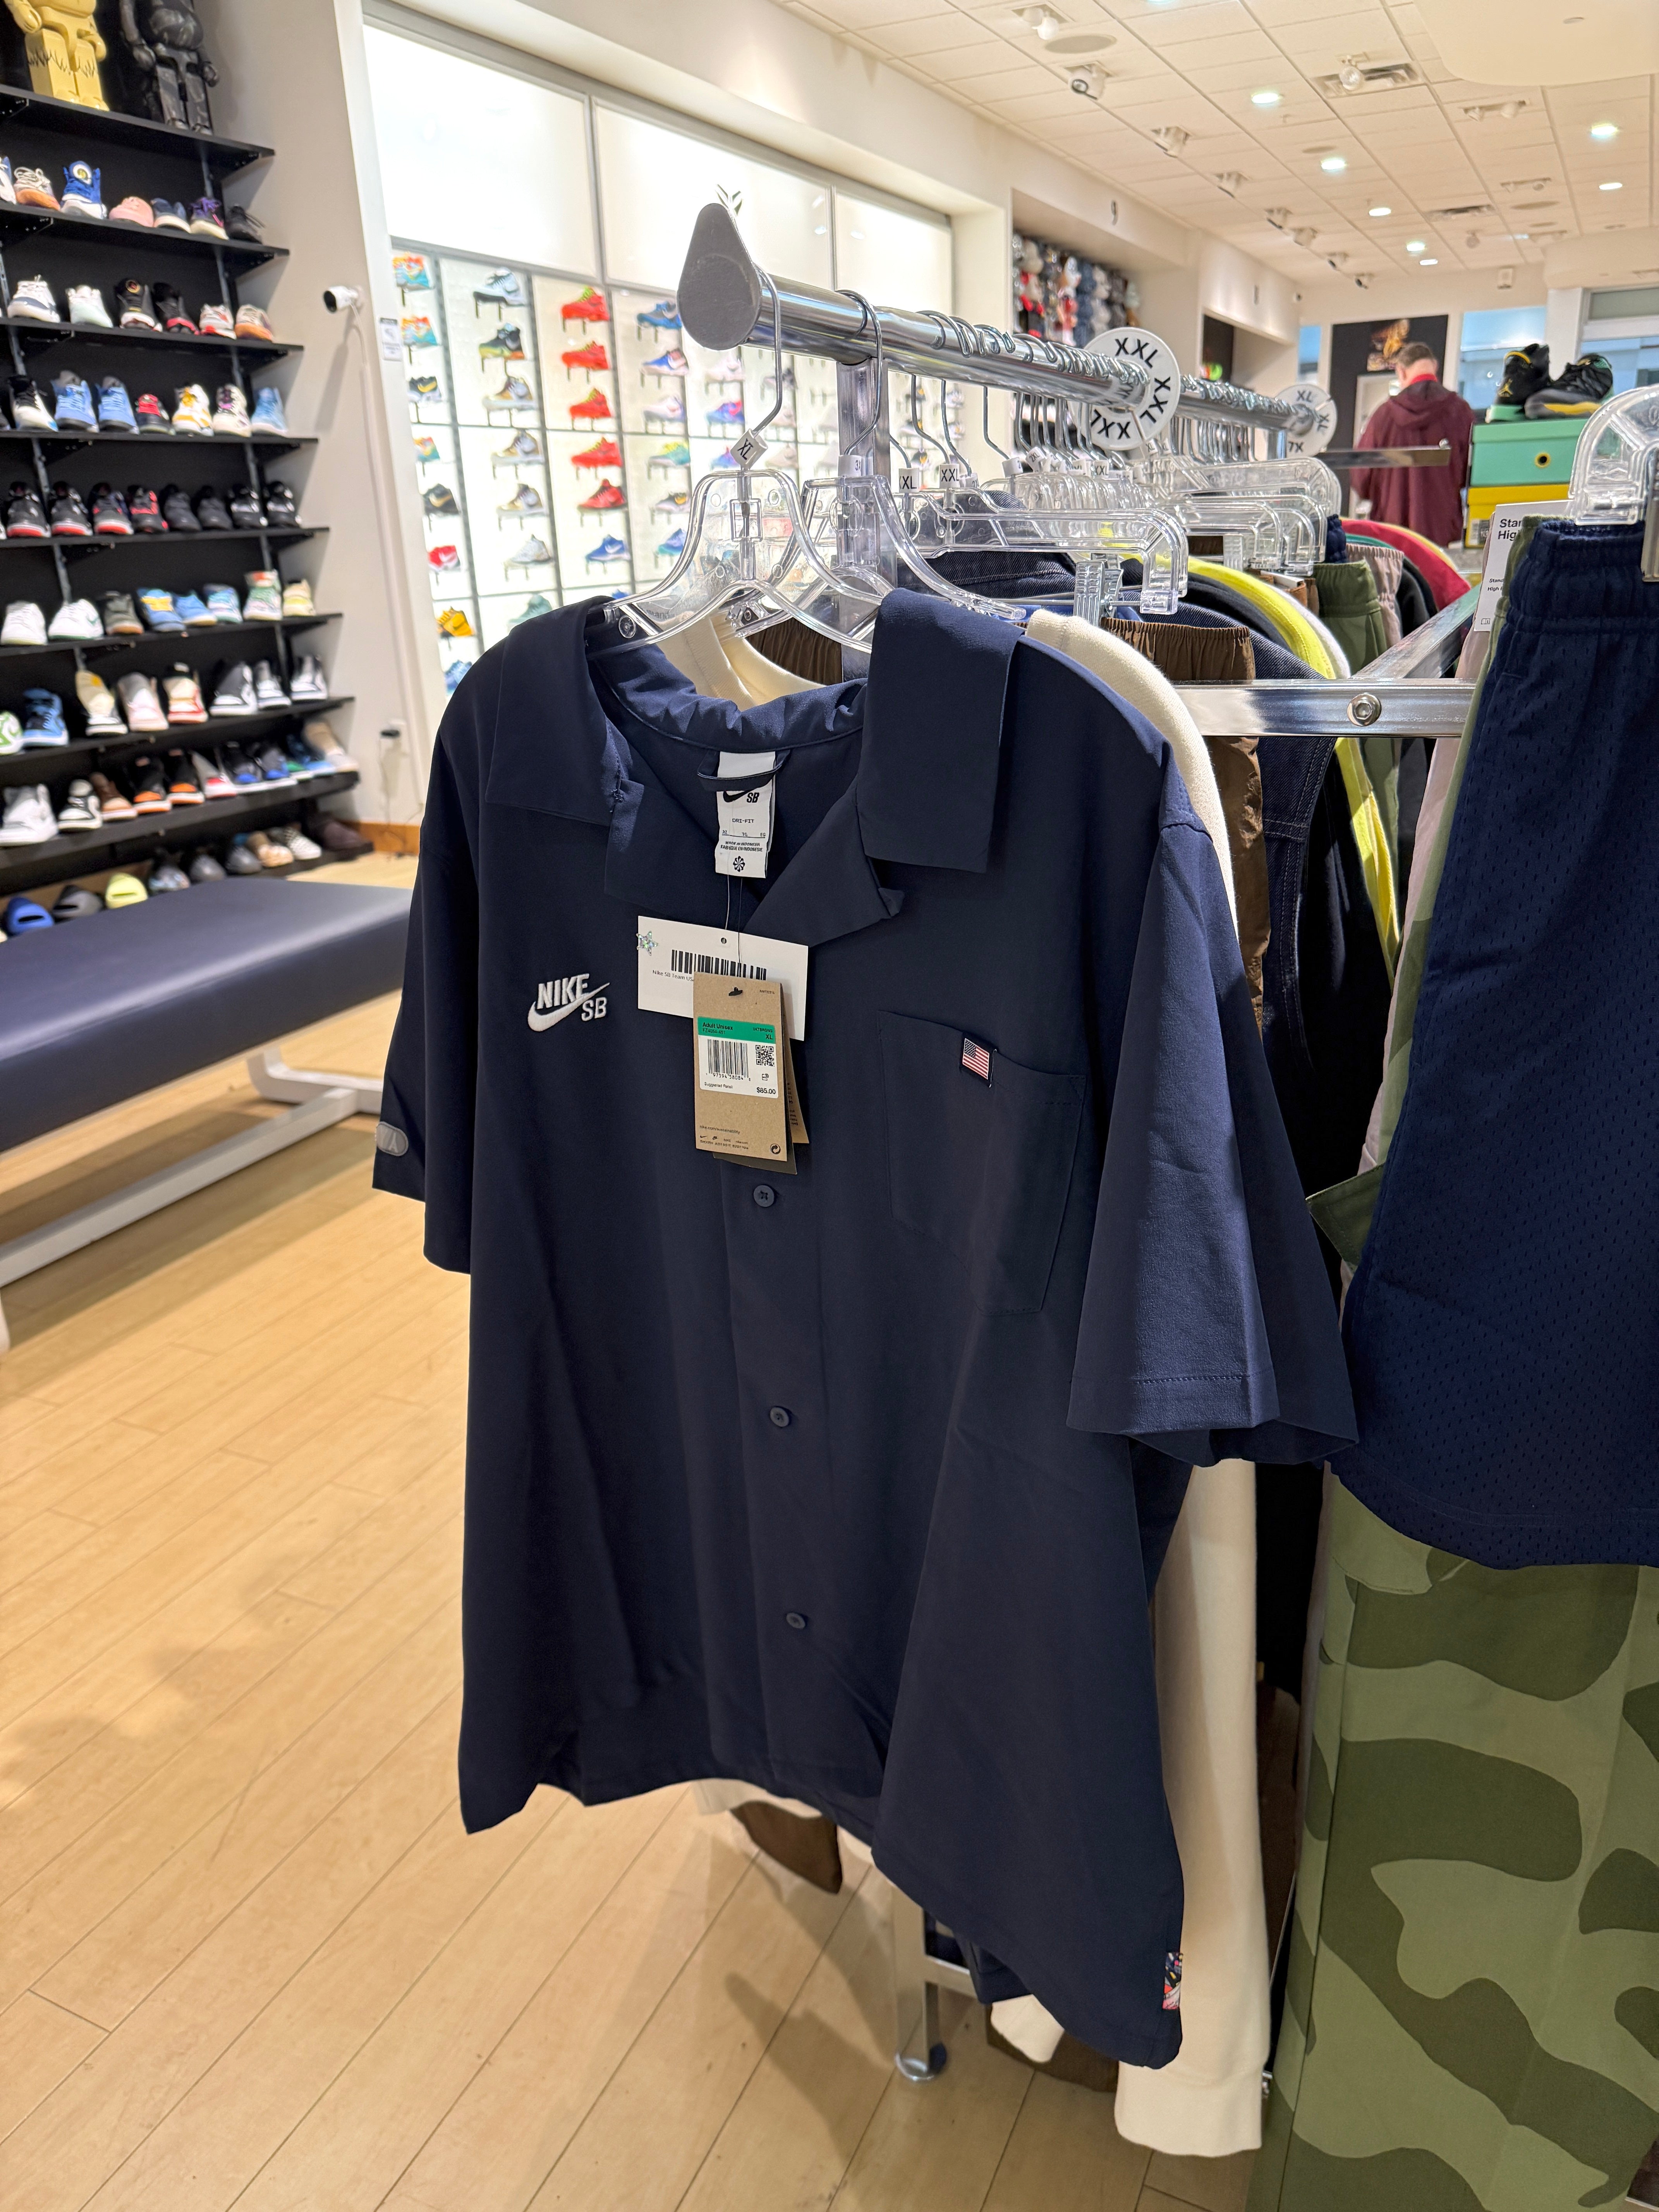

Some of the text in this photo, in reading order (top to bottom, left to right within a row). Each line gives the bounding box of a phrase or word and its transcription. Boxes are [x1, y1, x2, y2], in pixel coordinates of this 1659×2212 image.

[1115, 337, 1158, 369] XXL
[1139, 376, 1171, 424] XXL
[1297, 390, 1312, 403] XL
[737, 434, 753, 460] XL
[941, 468, 960, 482] XXL
[1498, 530, 1520, 541] Hig
[747, 792, 759, 803] SB
[537, 973, 590, 1010] NIKE
[581, 997, 607, 1022] SB
